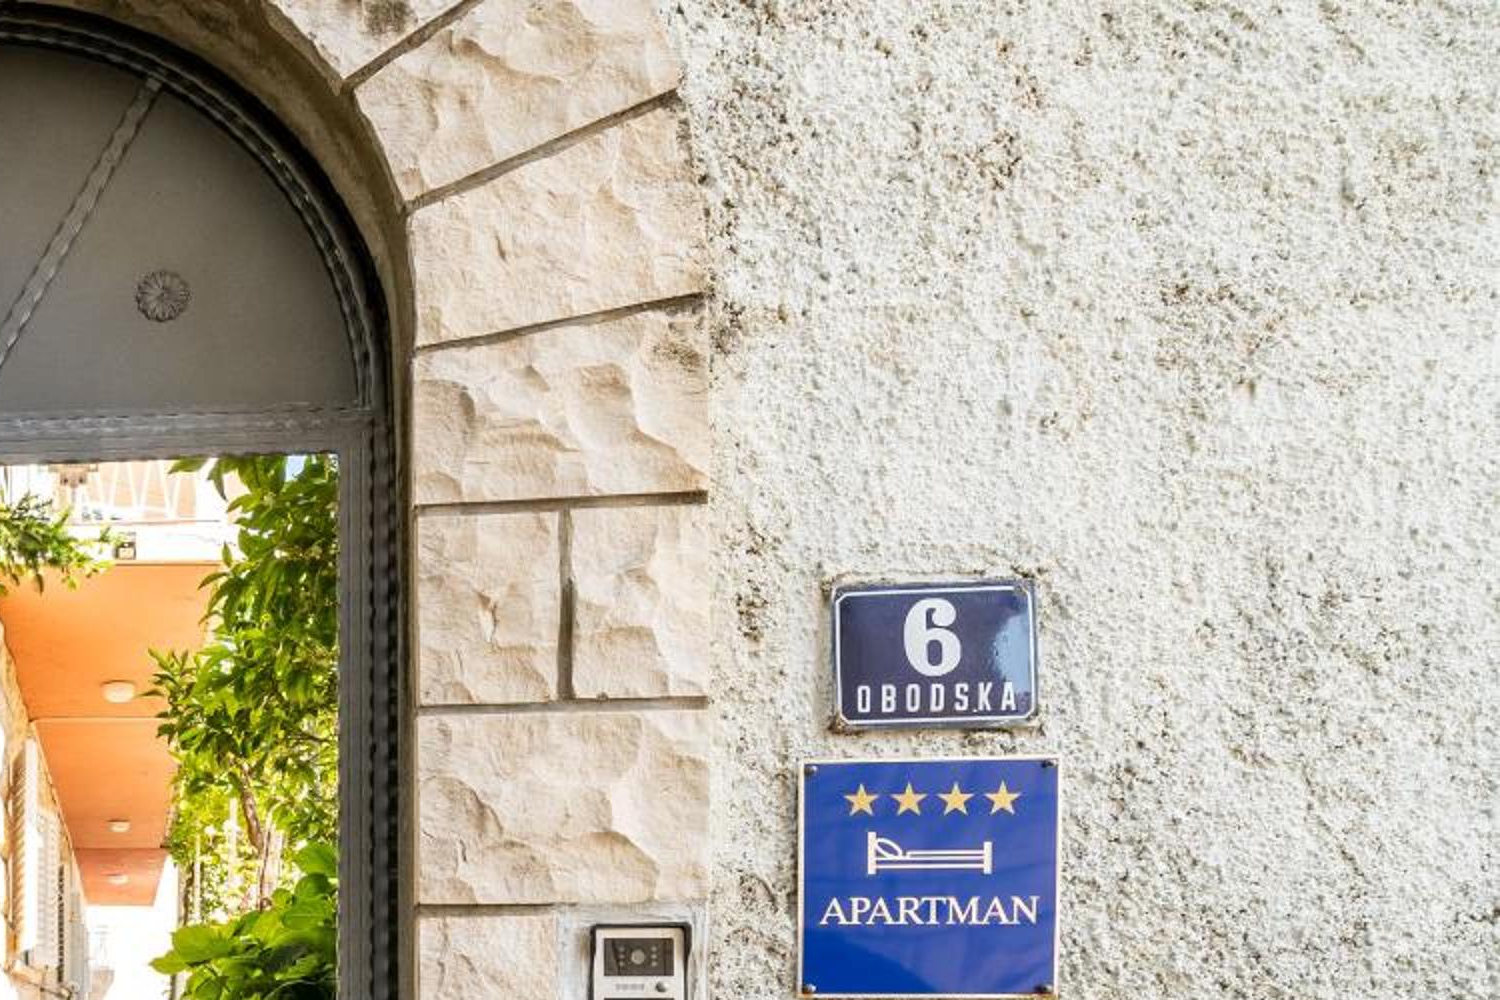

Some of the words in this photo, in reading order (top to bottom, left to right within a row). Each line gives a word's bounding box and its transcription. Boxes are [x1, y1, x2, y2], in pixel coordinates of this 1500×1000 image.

[903, 597, 962, 677] 6
[857, 681, 1017, 713] OBODSKA
[819, 895, 1040, 926] APARTMAN
